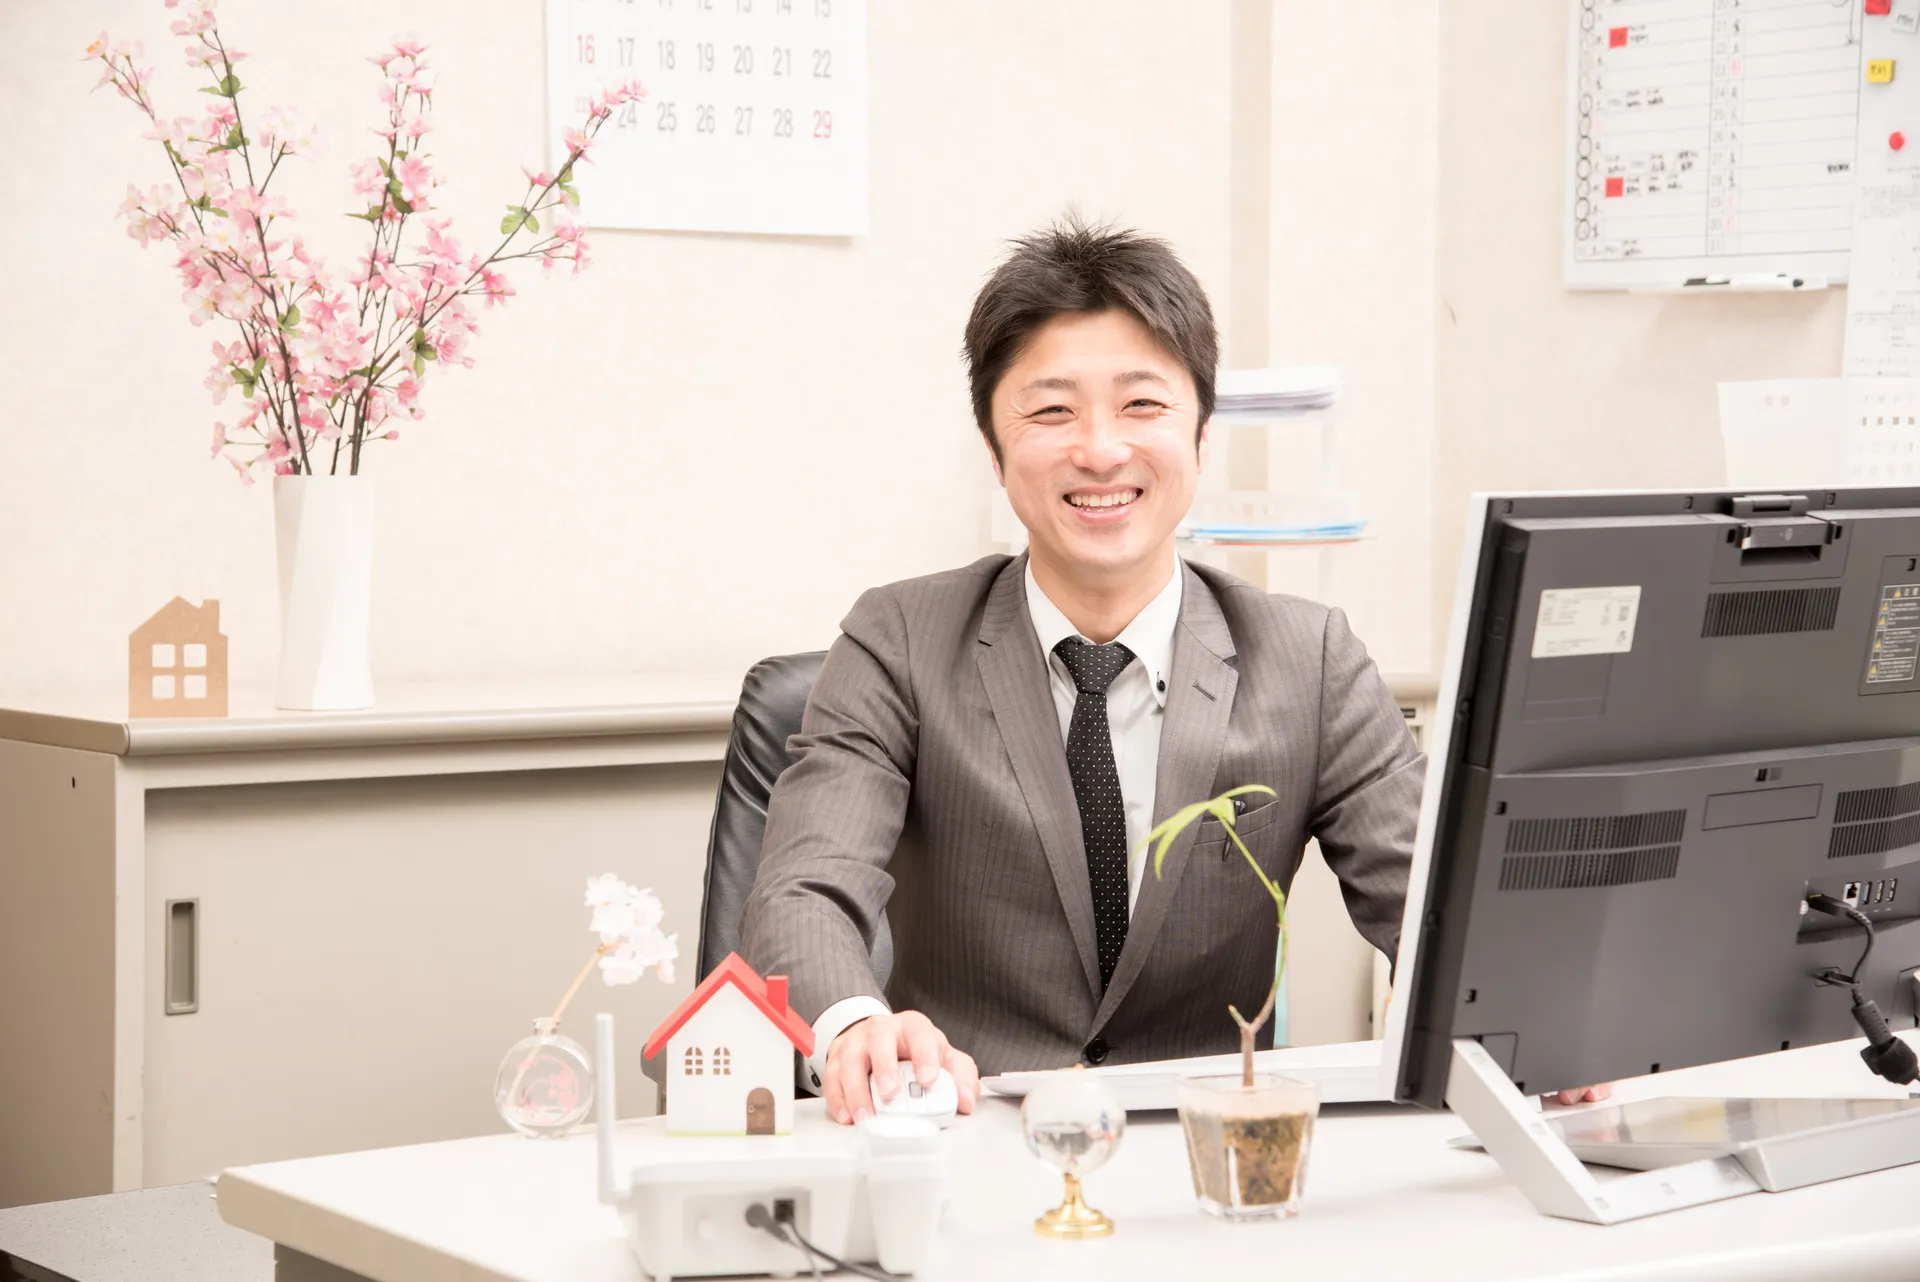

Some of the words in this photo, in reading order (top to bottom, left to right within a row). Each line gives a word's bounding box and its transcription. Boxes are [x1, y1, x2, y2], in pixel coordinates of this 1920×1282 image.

[576, 33, 596, 64] 16
[617, 37, 636, 67] 17
[657, 40, 676, 70] 18
[696, 42, 715, 73] 19
[733, 45, 753, 75] 20
[772, 47, 792, 77] 21
[812, 49, 833, 79] 22
[657, 102, 678, 132] 25
[695, 104, 716, 134] 26
[734, 106, 754, 136] 27
[773, 108, 794, 138] 28
[812, 110, 833, 139] 29
